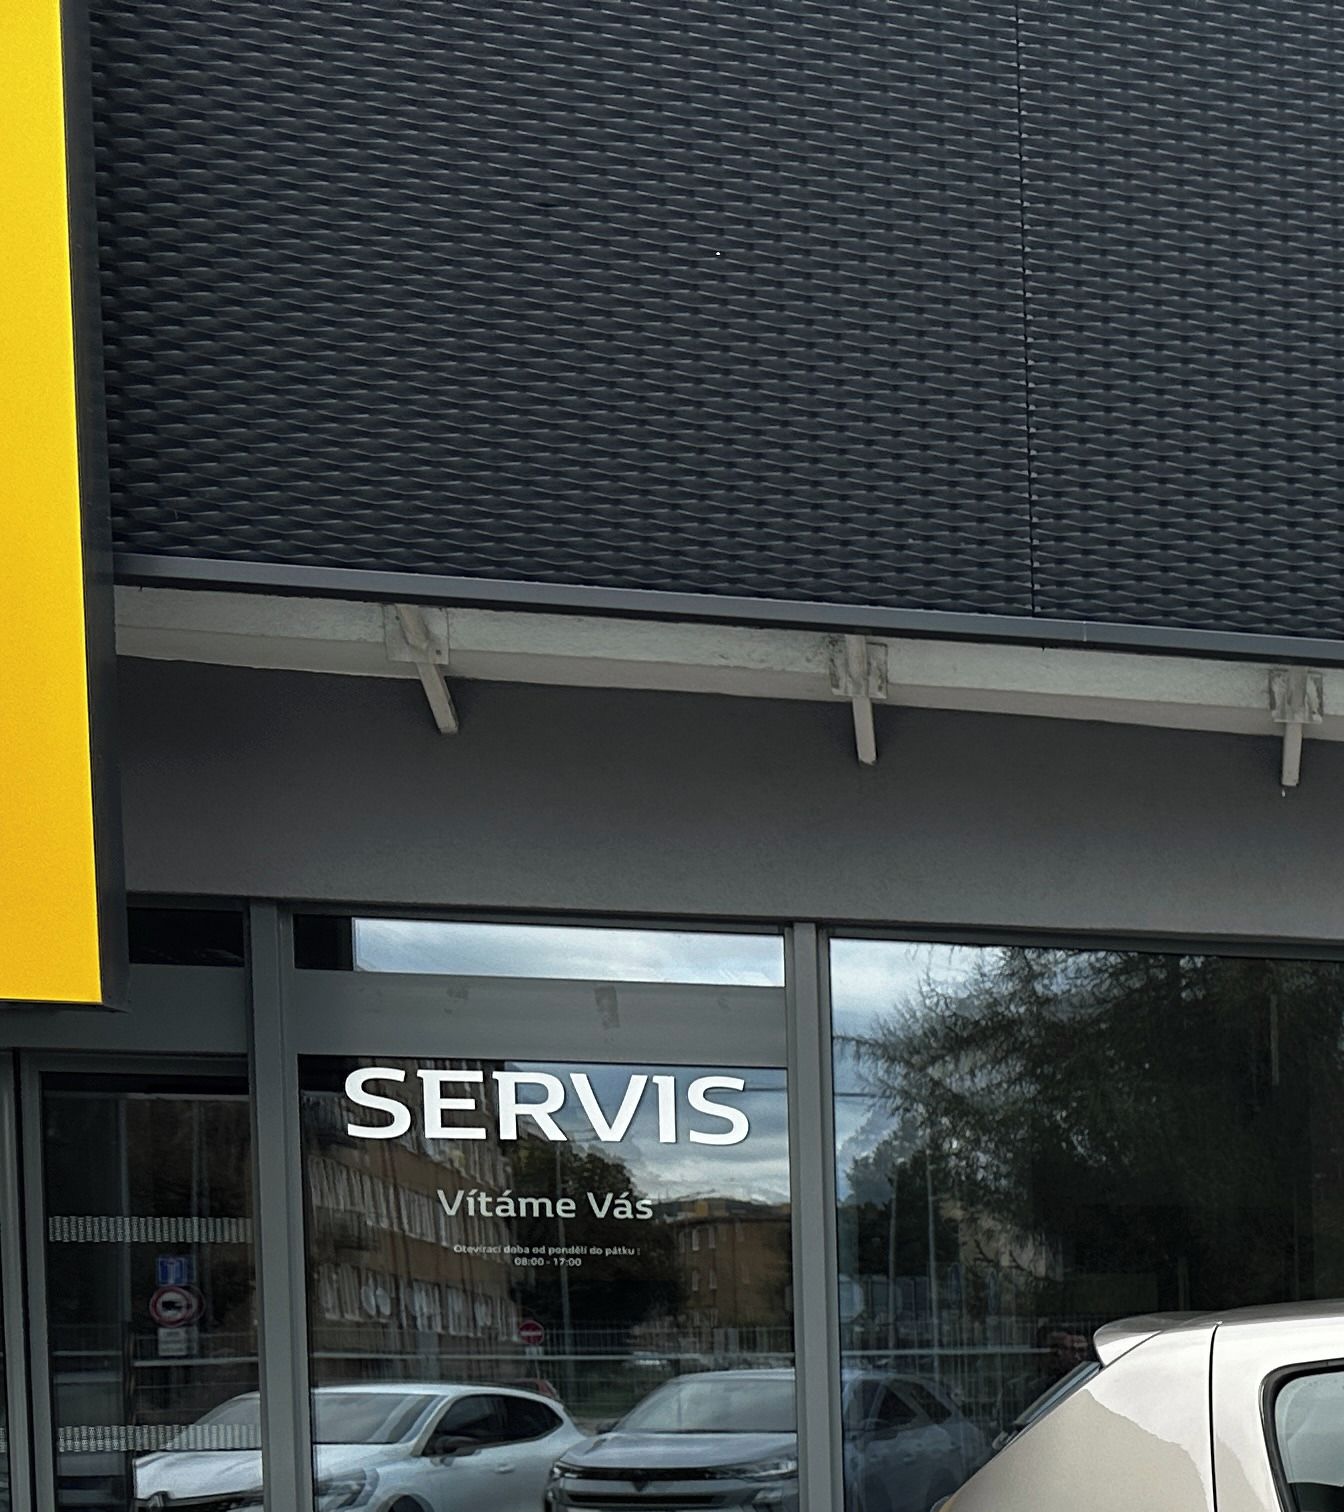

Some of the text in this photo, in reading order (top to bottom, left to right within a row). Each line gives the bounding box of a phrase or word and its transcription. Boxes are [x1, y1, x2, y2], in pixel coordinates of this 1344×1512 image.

[344, 1067, 750, 1146] SERVIS
[436, 1189, 654, 1220] Vítáme Vás
[504, 1244, 530, 1255] doba
[532, 1245, 546, 1255] od
[548, 1244, 587, 1257] pondělí
[589, 1246, 603, 1255] do
[605, 1245, 635, 1258] pátku
[514, 1257, 545, 1267] 08:00
[553, 1258, 582, 1267] 17:00
